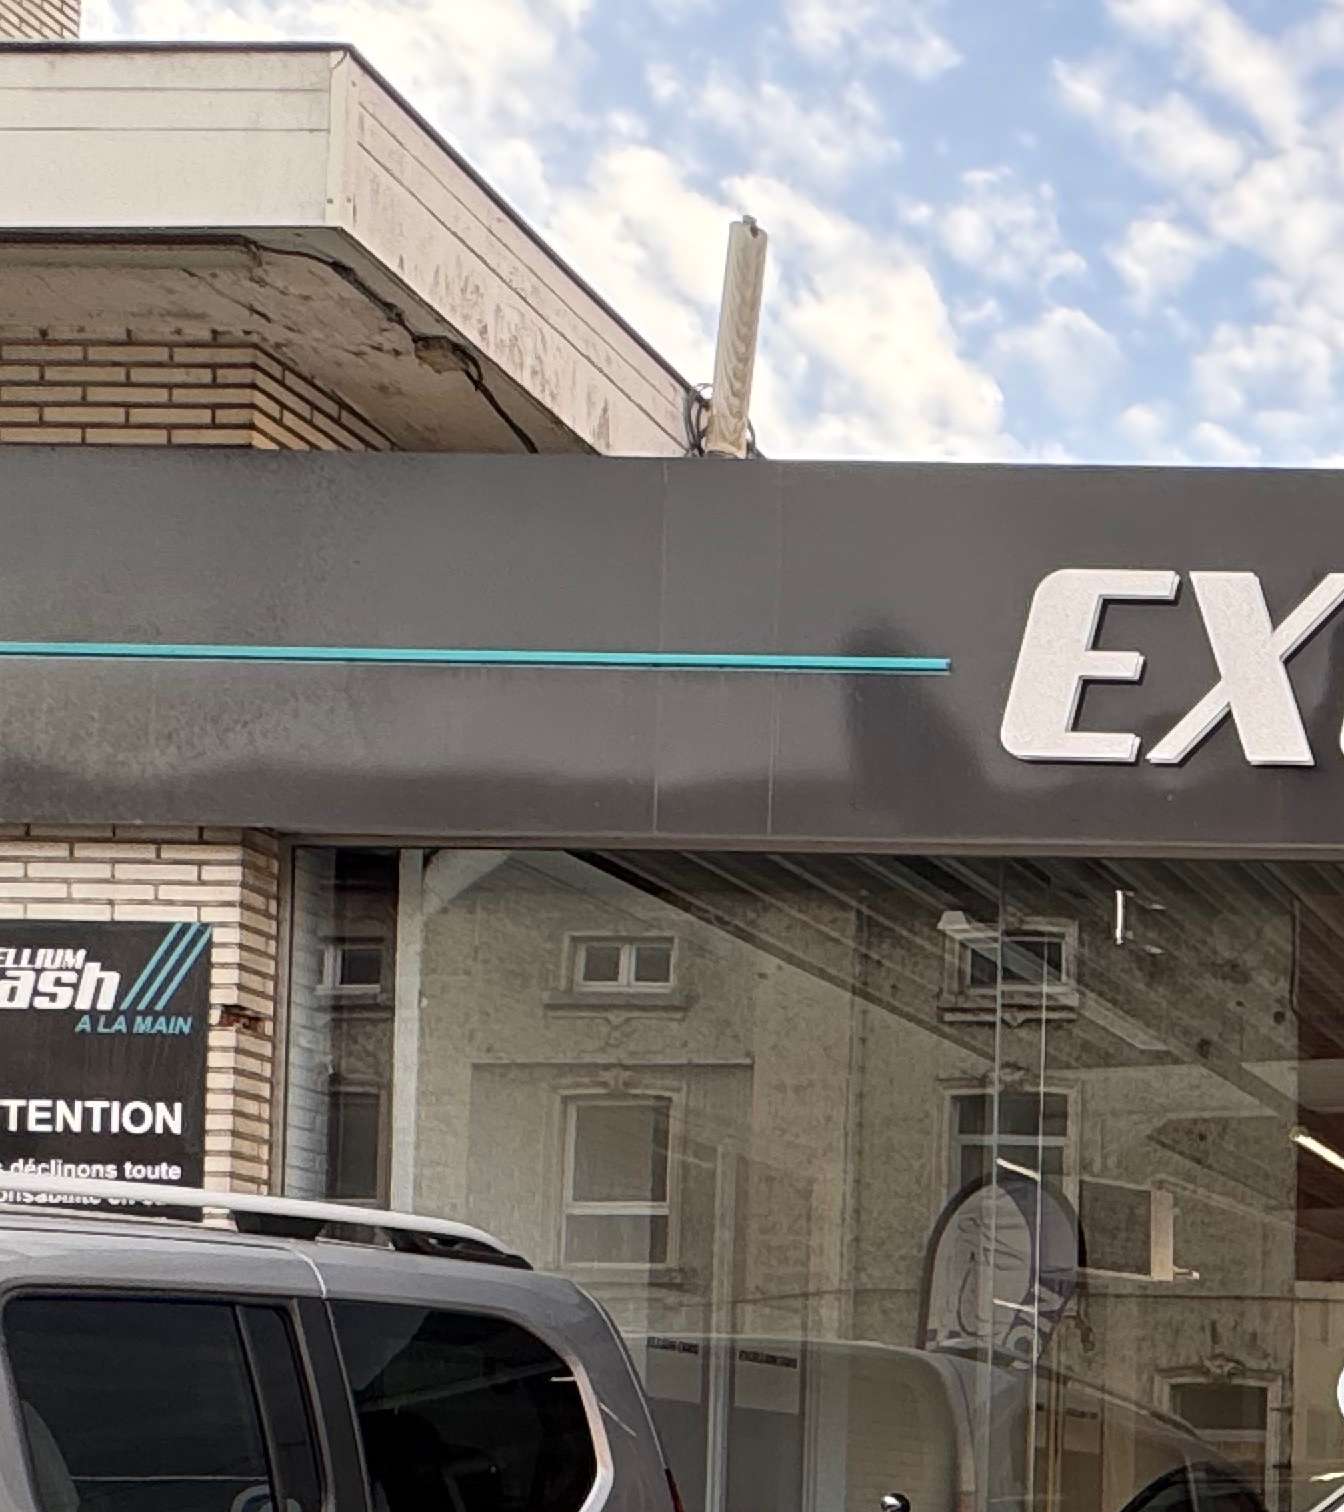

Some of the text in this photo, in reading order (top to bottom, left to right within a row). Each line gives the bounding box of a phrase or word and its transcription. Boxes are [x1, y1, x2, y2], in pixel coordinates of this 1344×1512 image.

[75, 1014, 193, 1035] A LA MAIN
[0, 1098, 182, 1136] TENTION
[10, 1158, 118, 1179] déclinons
[123, 1161, 182, 1180] toute
